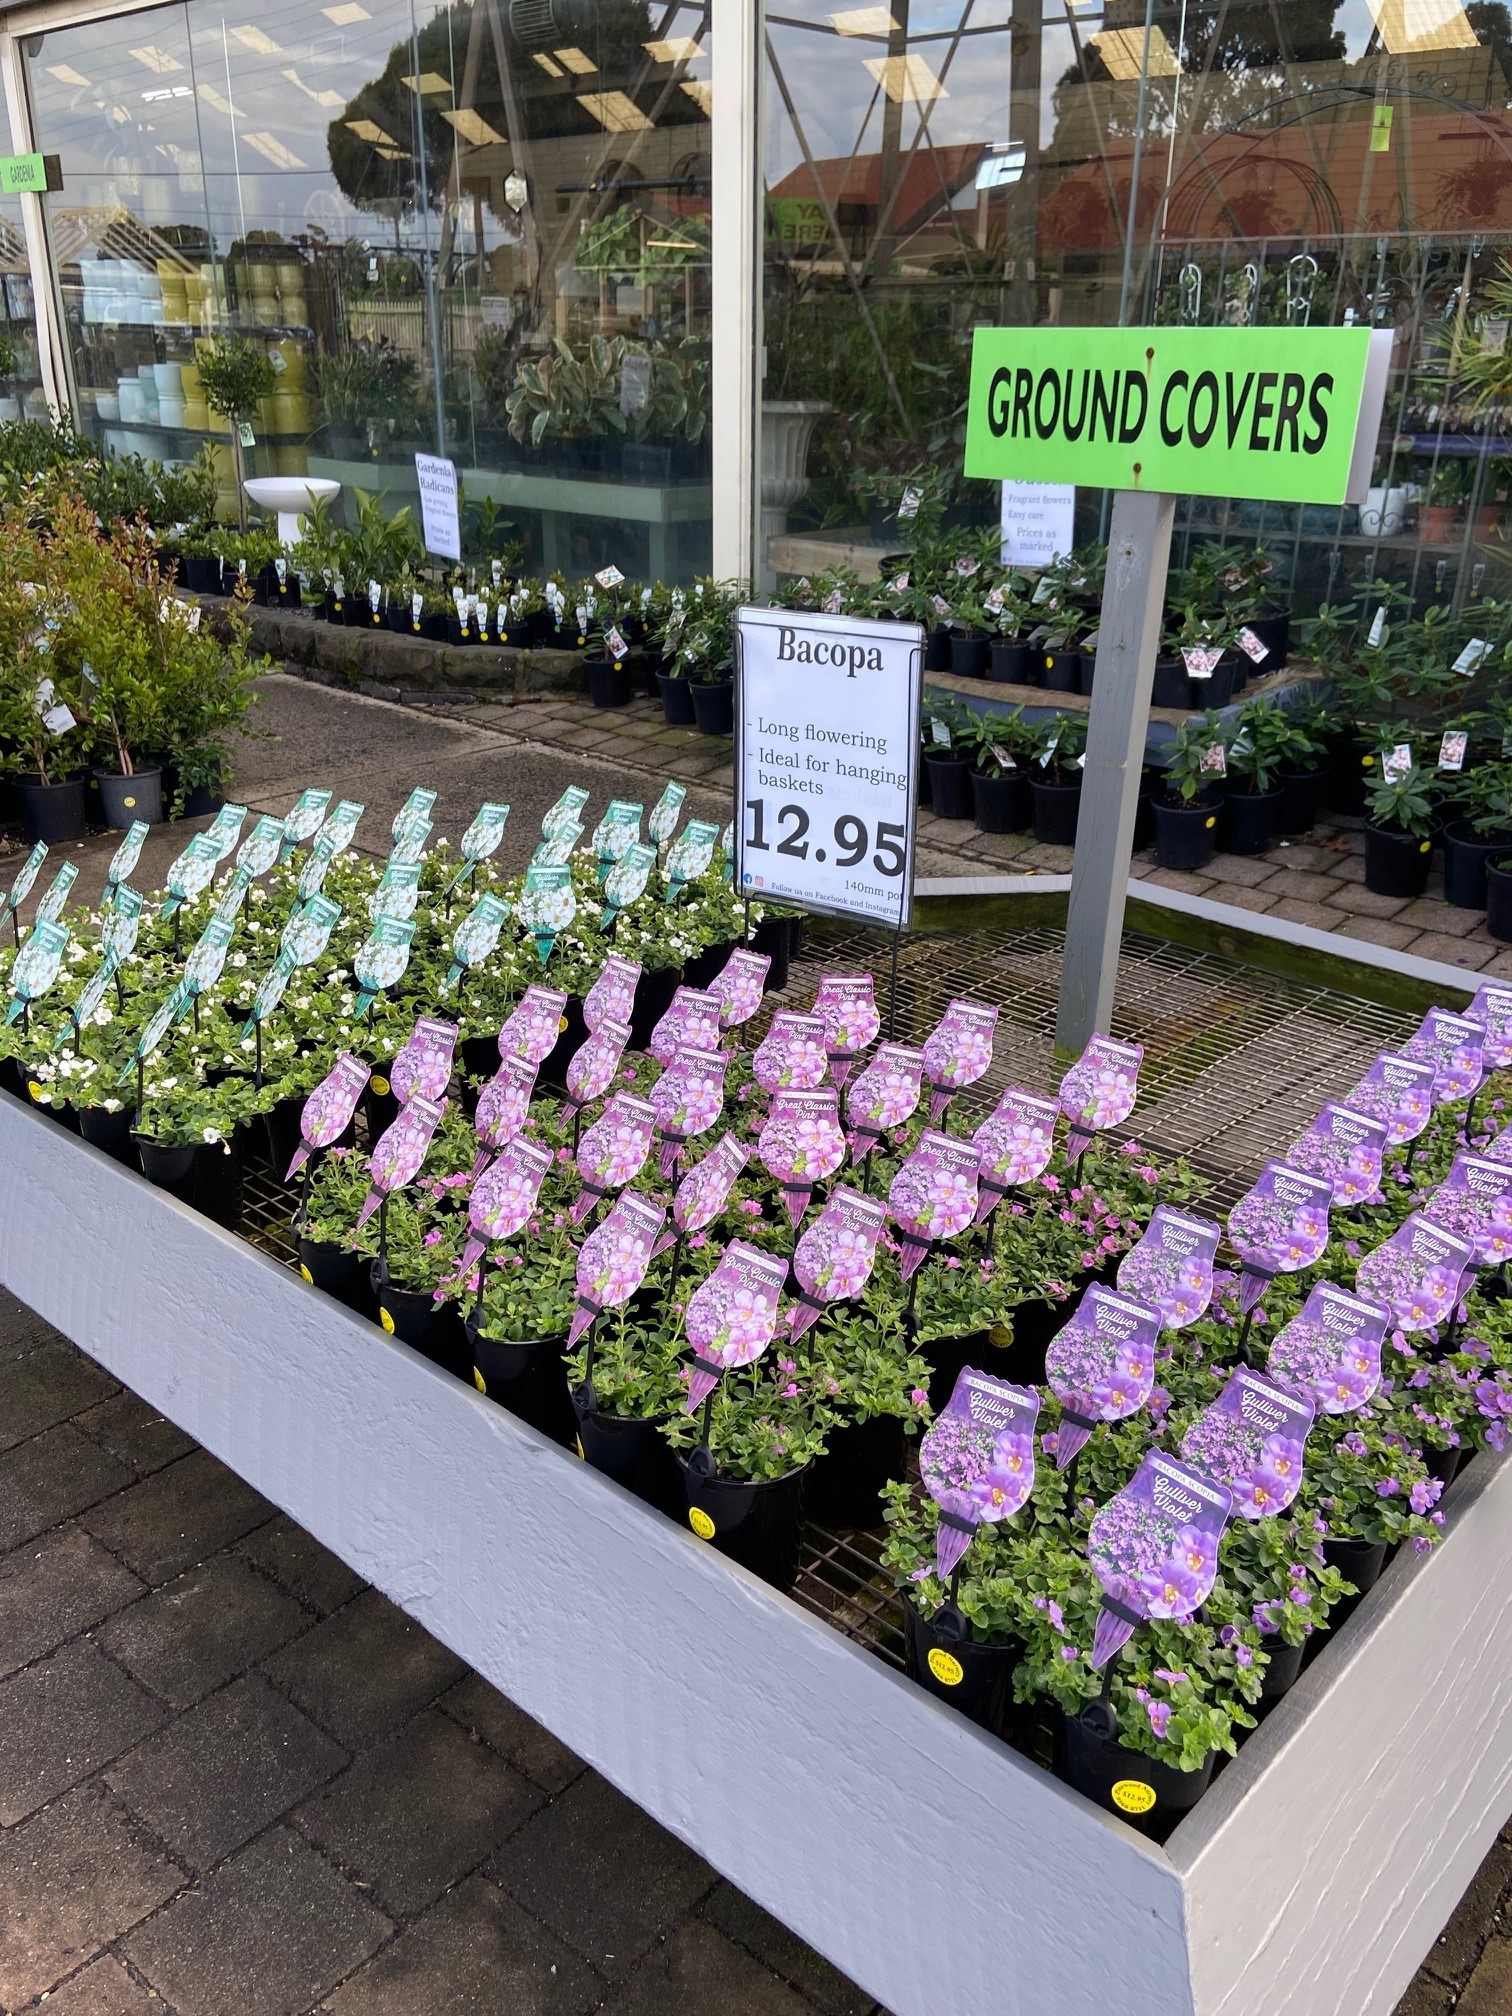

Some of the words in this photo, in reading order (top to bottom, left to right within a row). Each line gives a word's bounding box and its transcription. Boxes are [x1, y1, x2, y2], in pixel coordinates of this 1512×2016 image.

[987, 365, 1150, 444] GROUND
[1159, 369, 1334, 455] COVERS
[417, 461, 452, 477] Gardenia
[420, 477, 454, 495] Radicans
[1008, 494, 1040, 505] Fragrant
[1043, 495, 1072, 505] flowers
[1008, 510, 1026, 520] Easy
[1028, 512, 1044, 520] care
[1017, 527, 1043, 538] Prices
[1046, 530, 1056, 538] as
[1020, 541, 1053, 552] marked
[777, 627, 884, 678] Bacopa
[758, 717, 800, 742] Long
[805, 724, 888, 755] flowering
[759, 747, 800, 769] Ideal
[805, 755, 830, 772] for
[836, 759, 907, 791] hanging
[758, 770, 824, 796] baskets
[746, 798, 906, 878] 12.95
[771, 882, 793, 895] Follow
[794, 887, 803, 896] us
[804, 890, 814, 898] on
[815, 891, 848, 907] Facebook
[850, 899, 864, 909] and
[865, 901, 900, 916] Instagram
[844, 880, 884, 899] 140mm
[821, 985, 844, 995] Great
[844, 985, 872, 993] Classic
[837, 992, 858, 1001] Pink
[674, 997, 696, 1008] Great
[695, 1000, 719, 1013] Classic
[686, 1008, 705, 1018] Pink
[773, 1020, 797, 1031] Great
[797, 1023, 824, 1035] Classic
[947, 1009, 969, 1021] Great
[968, 1014, 993, 1028] Classic
[959, 1021, 978, 1032] Pink
[788, 1030, 808, 1040] Pink
[1435, 1021, 1470, 1039] Gulliver
[1435, 1032, 1464, 1046] Violet
[674, 1054, 698, 1067] Great
[697, 1059, 724, 1073] Classic
[876, 1052, 898, 1064] Great
[897, 1057, 922, 1070] Classic
[1088, 1045, 1111, 1059] Great
[1111, 1052, 1138, 1069] Classic
[1100, 1059, 1120, 1071] Pink
[687, 1067, 707, 1078] Pink
[887, 1063, 906, 1074] Pink
[1383, 1064, 1419, 1081] Gulliver
[1384, 1075, 1412, 1088] Violet
[609, 1101, 631, 1115] Great
[630, 1108, 655, 1124] Classic
[776, 1099, 803, 1111] Great
[803, 1100, 836, 1111] Classic
[795, 1110, 818, 1119] Pink
[1002, 1098, 1027, 1113] Great
[1027, 1105, 1055, 1122] Classic
[619, 1115, 638, 1128] Pink
[1015, 1112, 1035, 1126] Pink
[1331, 1116, 1370, 1138] Gulliver
[1332, 1127, 1363, 1145] Violet
[920, 1141, 947, 1158] Great
[946, 1150, 978, 1168] Classic
[935, 1157, 957, 1172] Pink
[1466, 1167, 1510, 1187] Gulliver
[1274, 1176, 1314, 1198] Gulliver
[1468, 1180, 1503, 1196] Violet
[1275, 1189, 1306, 1205] Violet
[614, 1202, 635, 1221] Great
[633, 1213, 657, 1235] Classic
[829, 1199, 854, 1216] Great
[853, 1207, 880, 1228] Classic
[623, 1221, 641, 1237] Pink
[840, 1215, 860, 1232] Pink
[1162, 1224, 1200, 1247] Gulliver
[1412, 1229, 1451, 1257] Gulliver
[1162, 1237, 1193, 1256] Violet
[1412, 1242, 1442, 1264] Violet
[724, 1254, 751, 1274] Great
[750, 1266, 781, 1288] Classic
[737, 1273, 759, 1291] Pink
[1097, 1293, 1122, 1308] BACOPA
[1124, 1304, 1148, 1318] SCOPIA
[1324, 1290, 1350, 1305] BACOPA
[1352, 1302, 1376, 1315] SCOPIA
[1096, 1303, 1138, 1330] Gulliver
[1322, 1301, 1366, 1327] Gulliver
[1096, 1319, 1130, 1340] Violet
[1323, 1315, 1358, 1336] Violet
[970, 1379, 997, 1395] BACOPA
[999, 1390, 1024, 1404] SCOPIA
[1244, 1378, 1272, 1395] BACOPA
[1273, 1393, 1299, 1410] SCOPIA
[970, 1391, 1016, 1419] Gulliver
[1241, 1389, 1289, 1423] Gulliver
[971, 1407, 1007, 1429] Violet
[1241, 1406, 1280, 1432] Violet
[1157, 1462, 1186, 1483] BACOPA
[1188, 1479, 1216, 1500] SCOPIA
[1153, 1475, 1203, 1513] Gulliver
[1153, 1493, 1193, 1523] Violet
